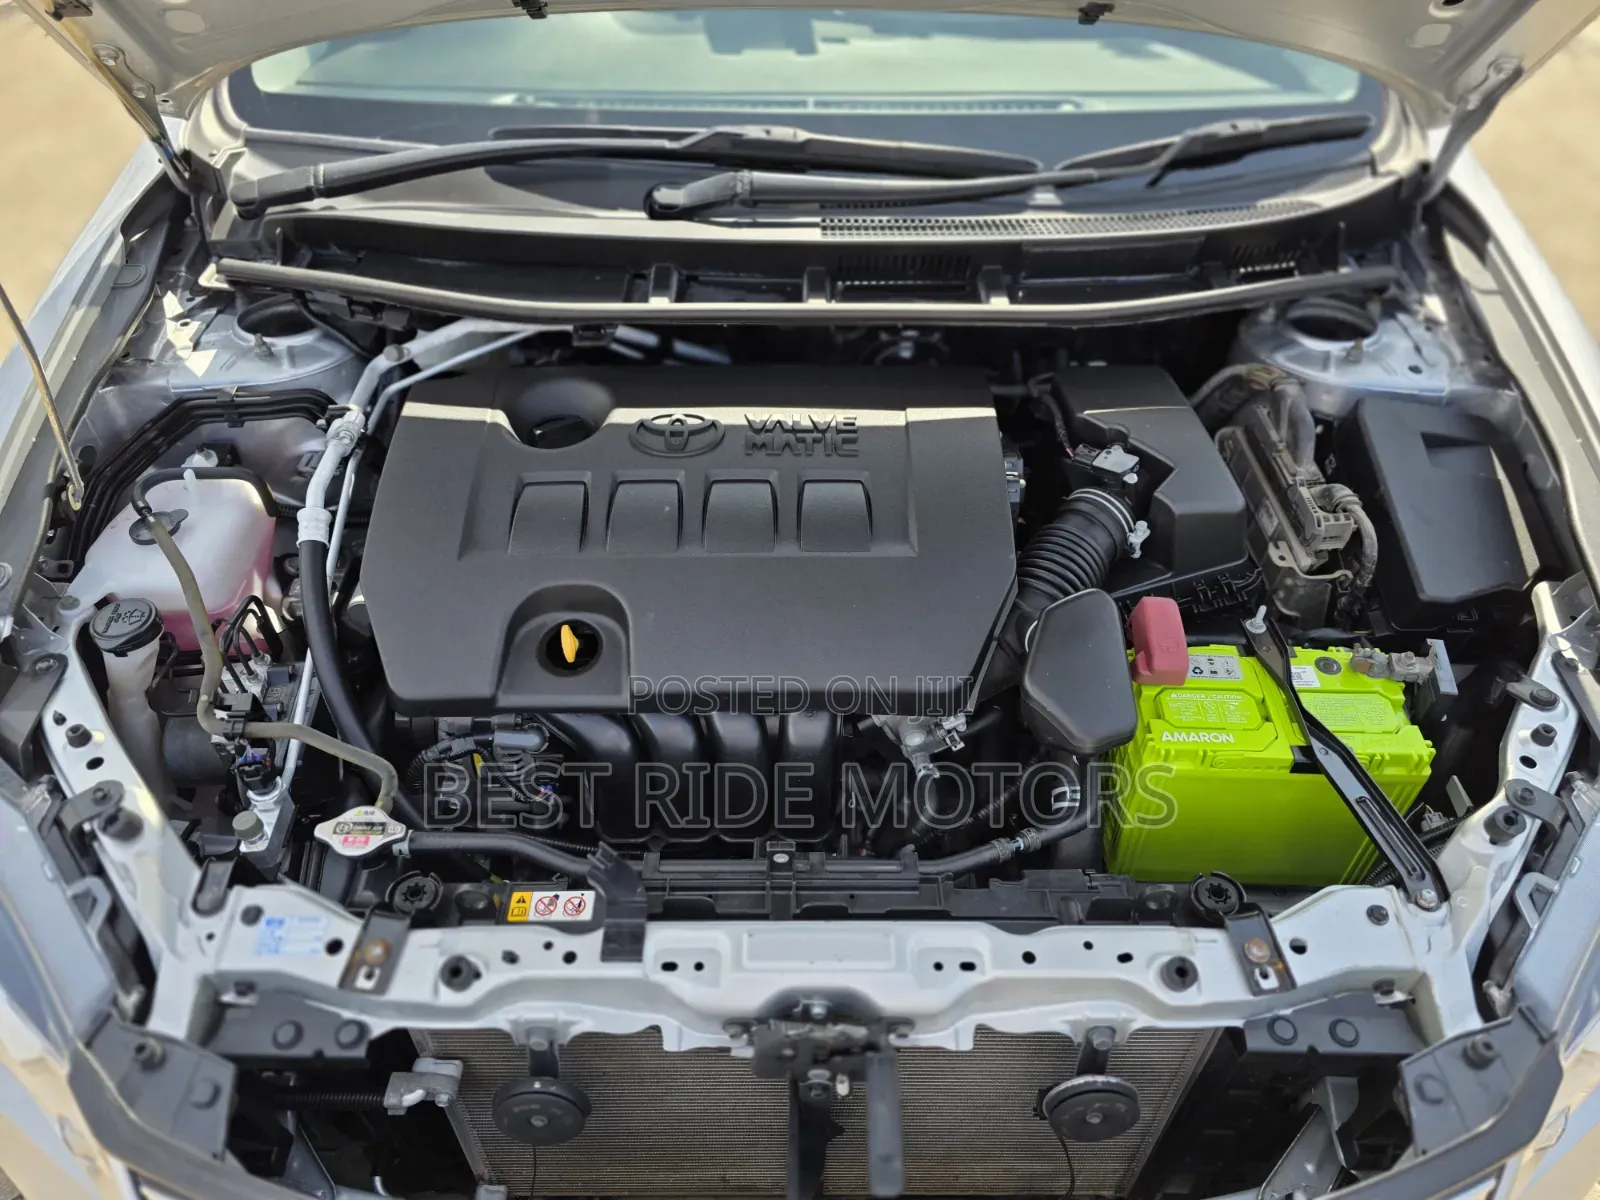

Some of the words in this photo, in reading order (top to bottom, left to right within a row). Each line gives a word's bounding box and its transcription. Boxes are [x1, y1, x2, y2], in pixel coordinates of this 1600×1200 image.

[744, 413, 858, 435] VALVE
[744, 433, 859, 457] MATIC
[1161, 731, 1235, 744] AMARON
